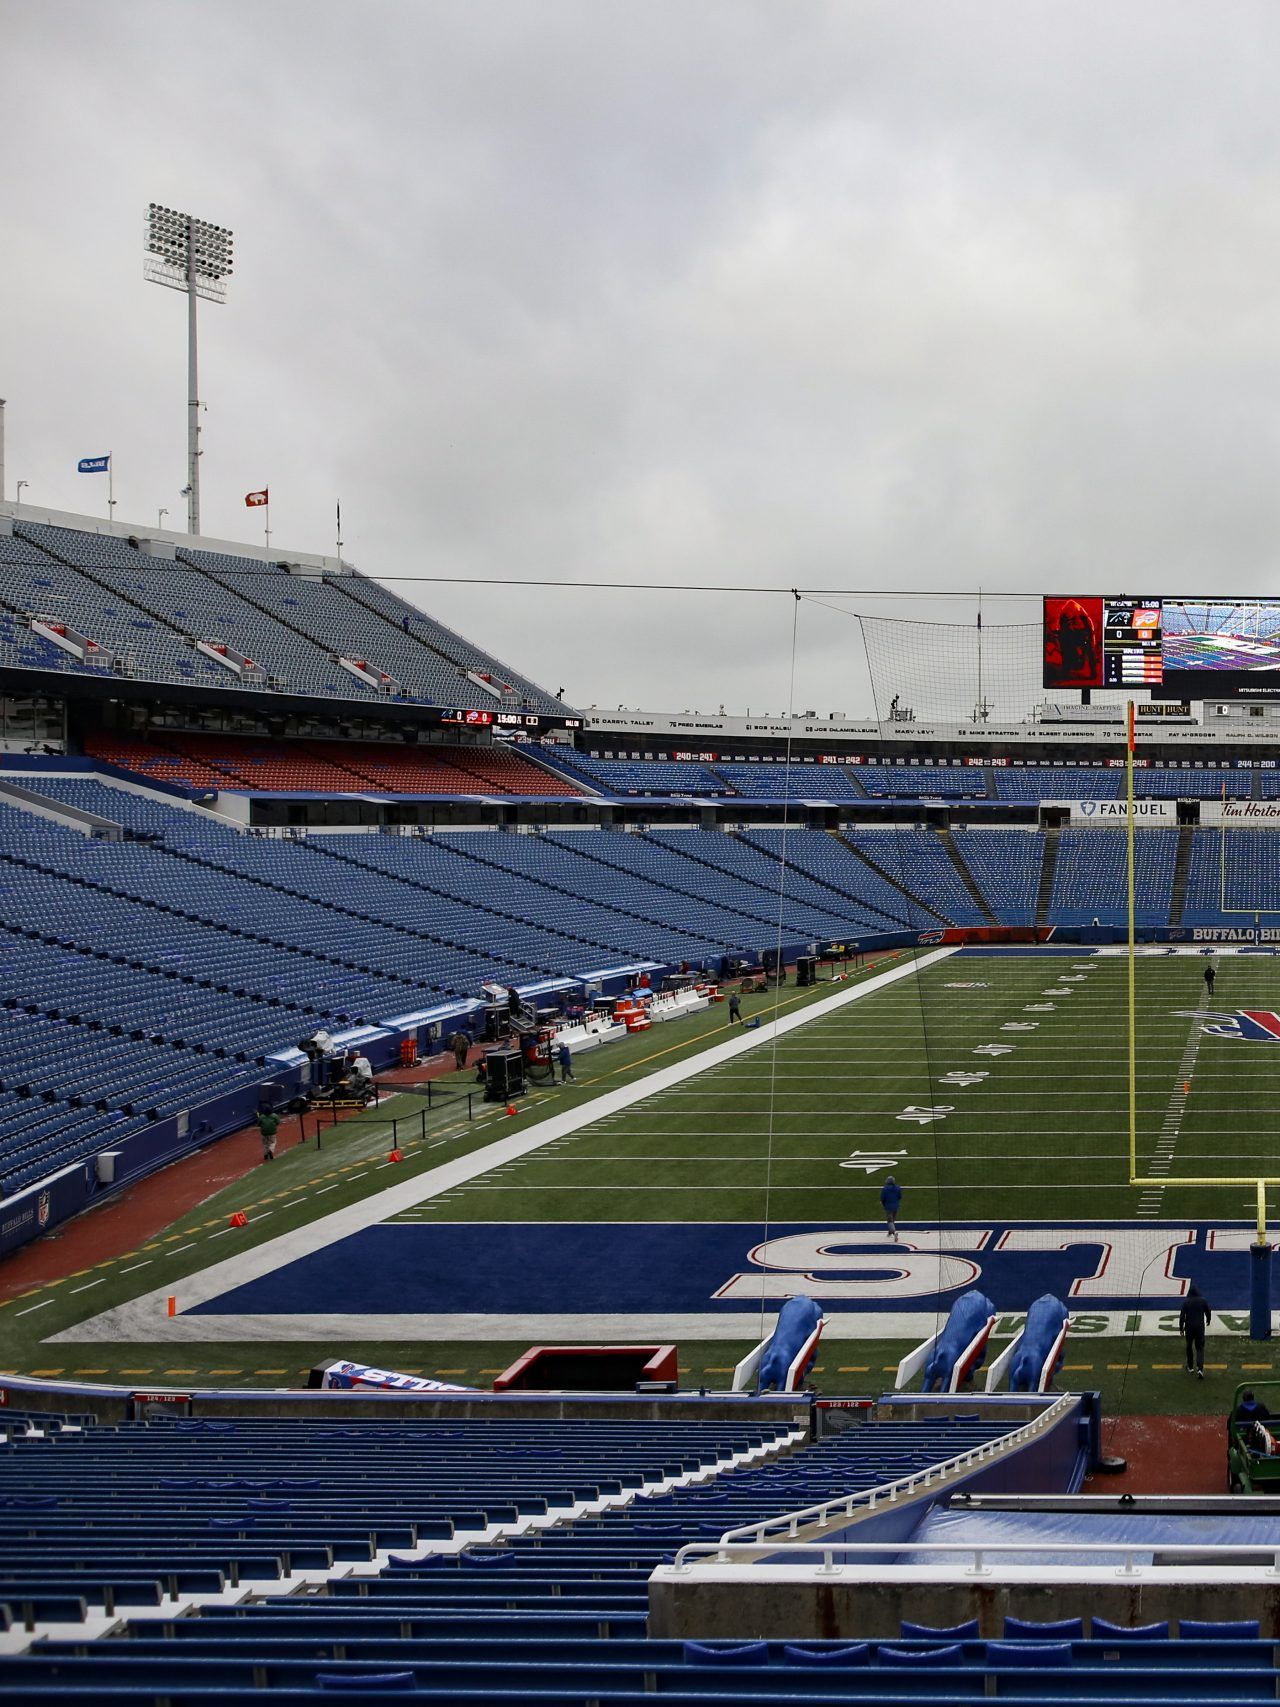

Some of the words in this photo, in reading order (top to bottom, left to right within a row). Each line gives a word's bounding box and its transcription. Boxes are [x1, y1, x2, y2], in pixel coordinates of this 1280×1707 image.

[1116, 630, 1122, 638] 0
[1140, 706, 1163, 714] HUNT
[1166, 706, 1189, 714] HUNT
[457, 711, 462, 720] 0
[482, 713, 487, 722] 0
[497, 714, 517, 724] 15:00
[676, 752, 691, 760] 240
[699, 753, 713, 761] 241
[823, 756, 837, 764] 241
[845, 756, 861, 764] 242
[968, 758, 984, 766] 242
[991, 758, 1006, 766] 243
[1109, 759, 1124, 767] 243
[1132, 759, 1147, 767] 244
[1237, 760, 1252, 768] 244
[1260, 760, 1276, 768] 200
[1100, 804, 1167, 815] FANDUEL
[1220, 802, 1242, 817] Tim
[1193, 928, 1255, 941] BUFFALO
[896, 1105, 955, 1120] 20
[839, 1149, 908, 1168] 10
